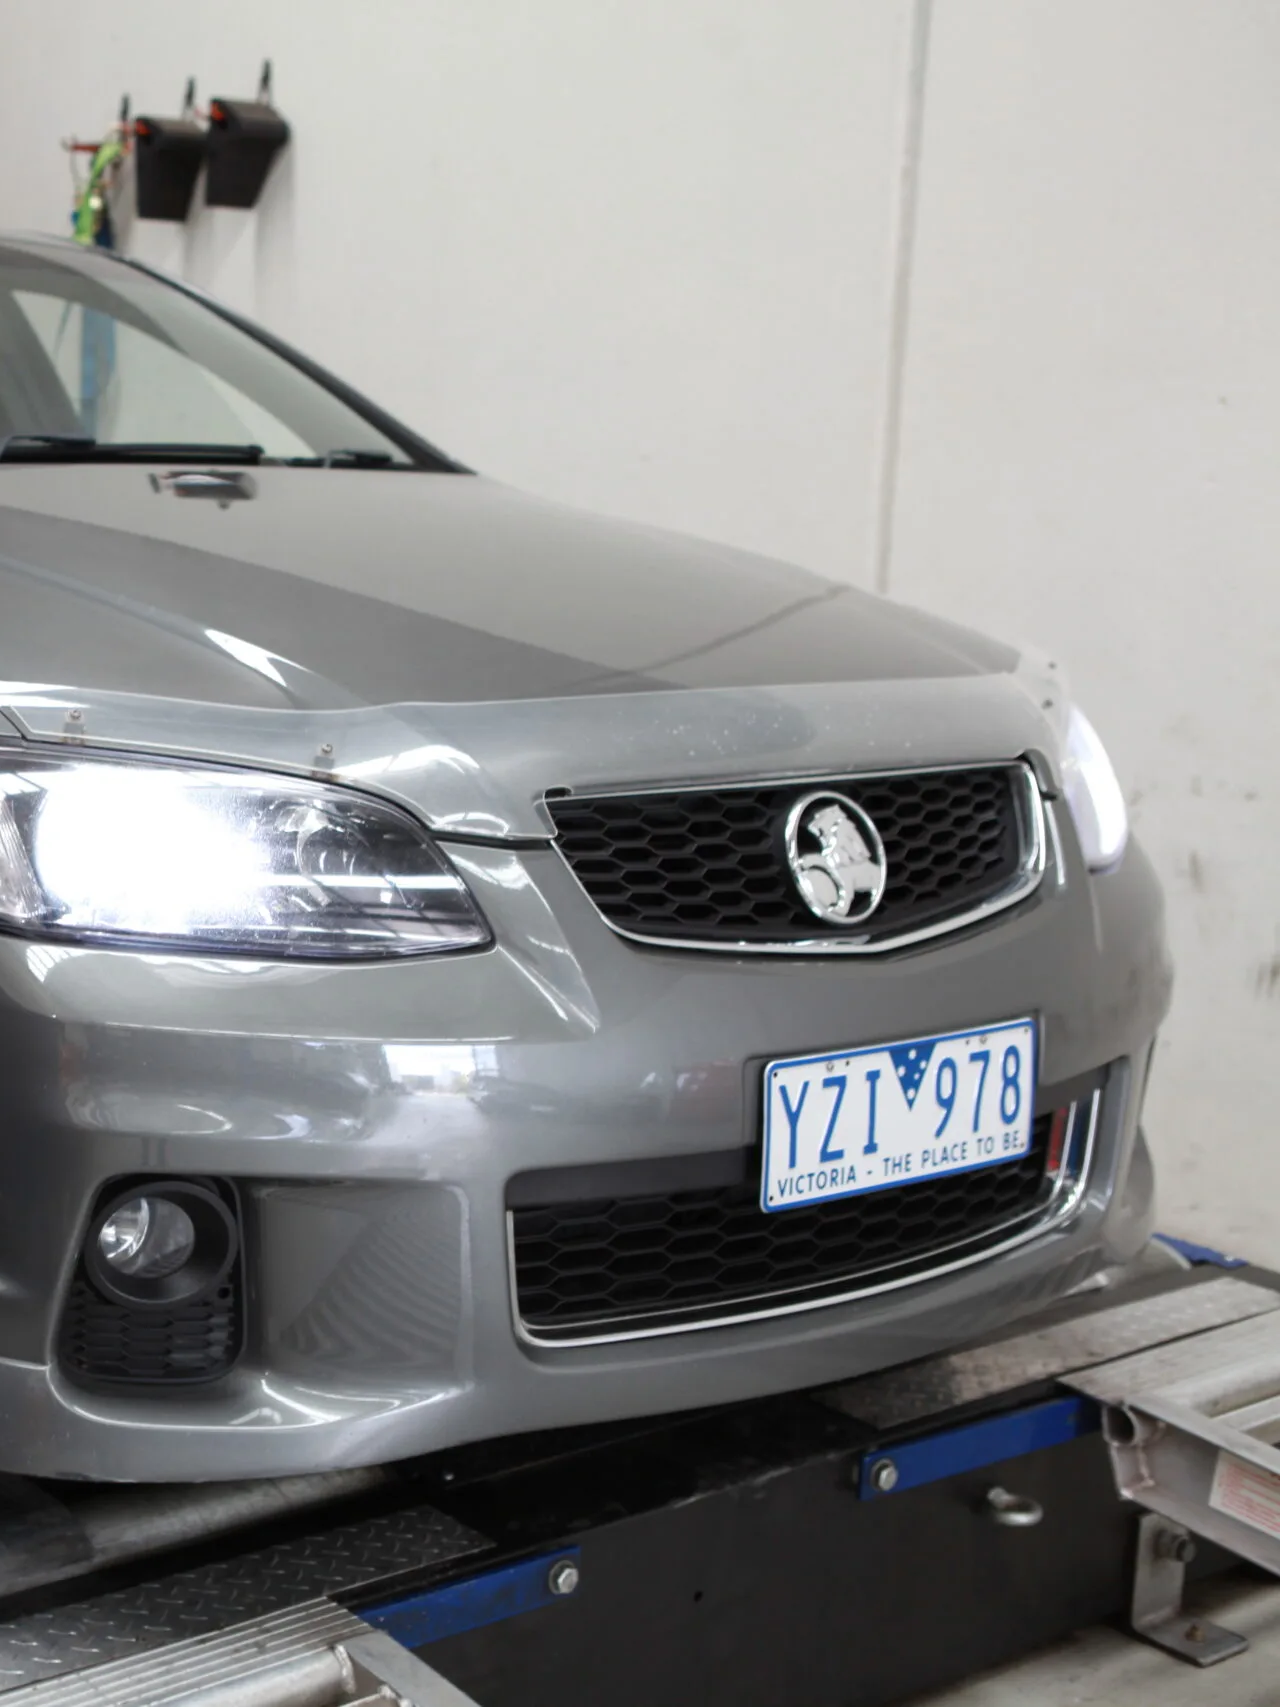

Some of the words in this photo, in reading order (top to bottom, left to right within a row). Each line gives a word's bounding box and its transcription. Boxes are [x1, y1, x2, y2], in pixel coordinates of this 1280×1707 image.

[779, 1069, 881, 1169] YZI
[935, 1045, 1021, 1139] 978
[777, 1165, 857, 1198] VICTORIA
[883, 1152, 912, 1177] THE
[921, 1141, 969, 1169] PLACE
[976, 1136, 995, 1157] TO
